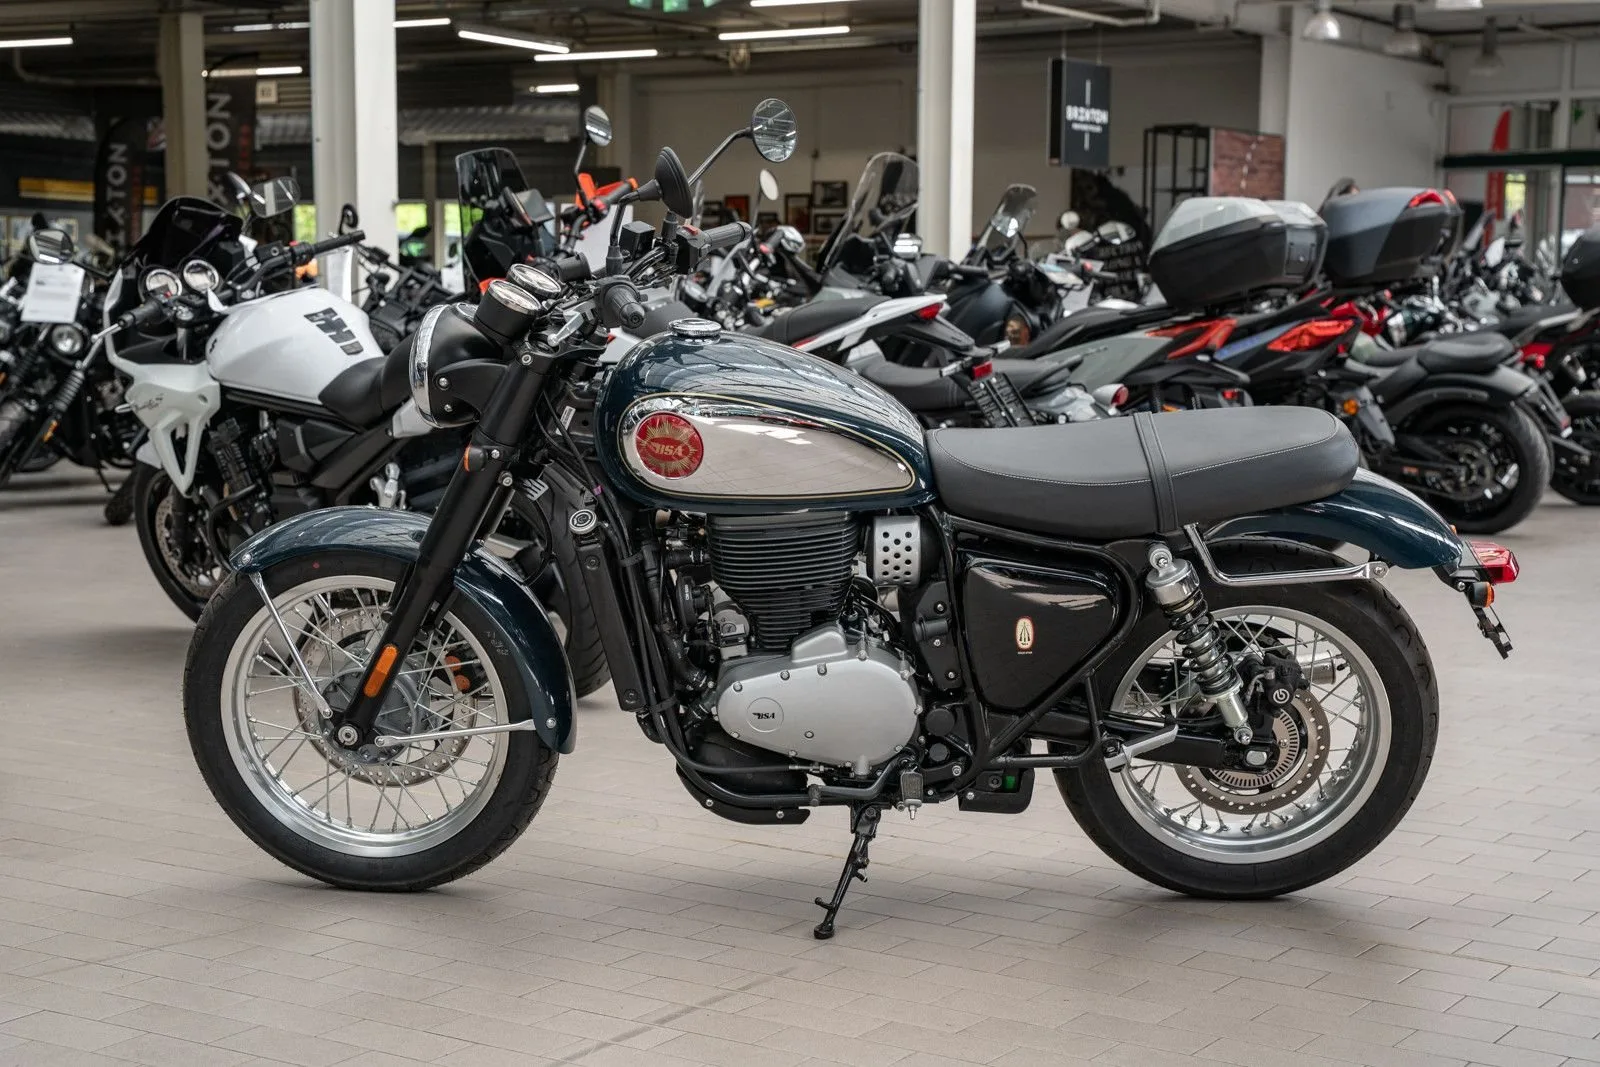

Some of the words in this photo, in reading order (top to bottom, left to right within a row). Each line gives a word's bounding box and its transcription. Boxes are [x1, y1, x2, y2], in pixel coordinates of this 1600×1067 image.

[206, 93, 232, 206] XTON
[649, 441, 683, 457] BSA
[752, 712, 776, 720] BSA
